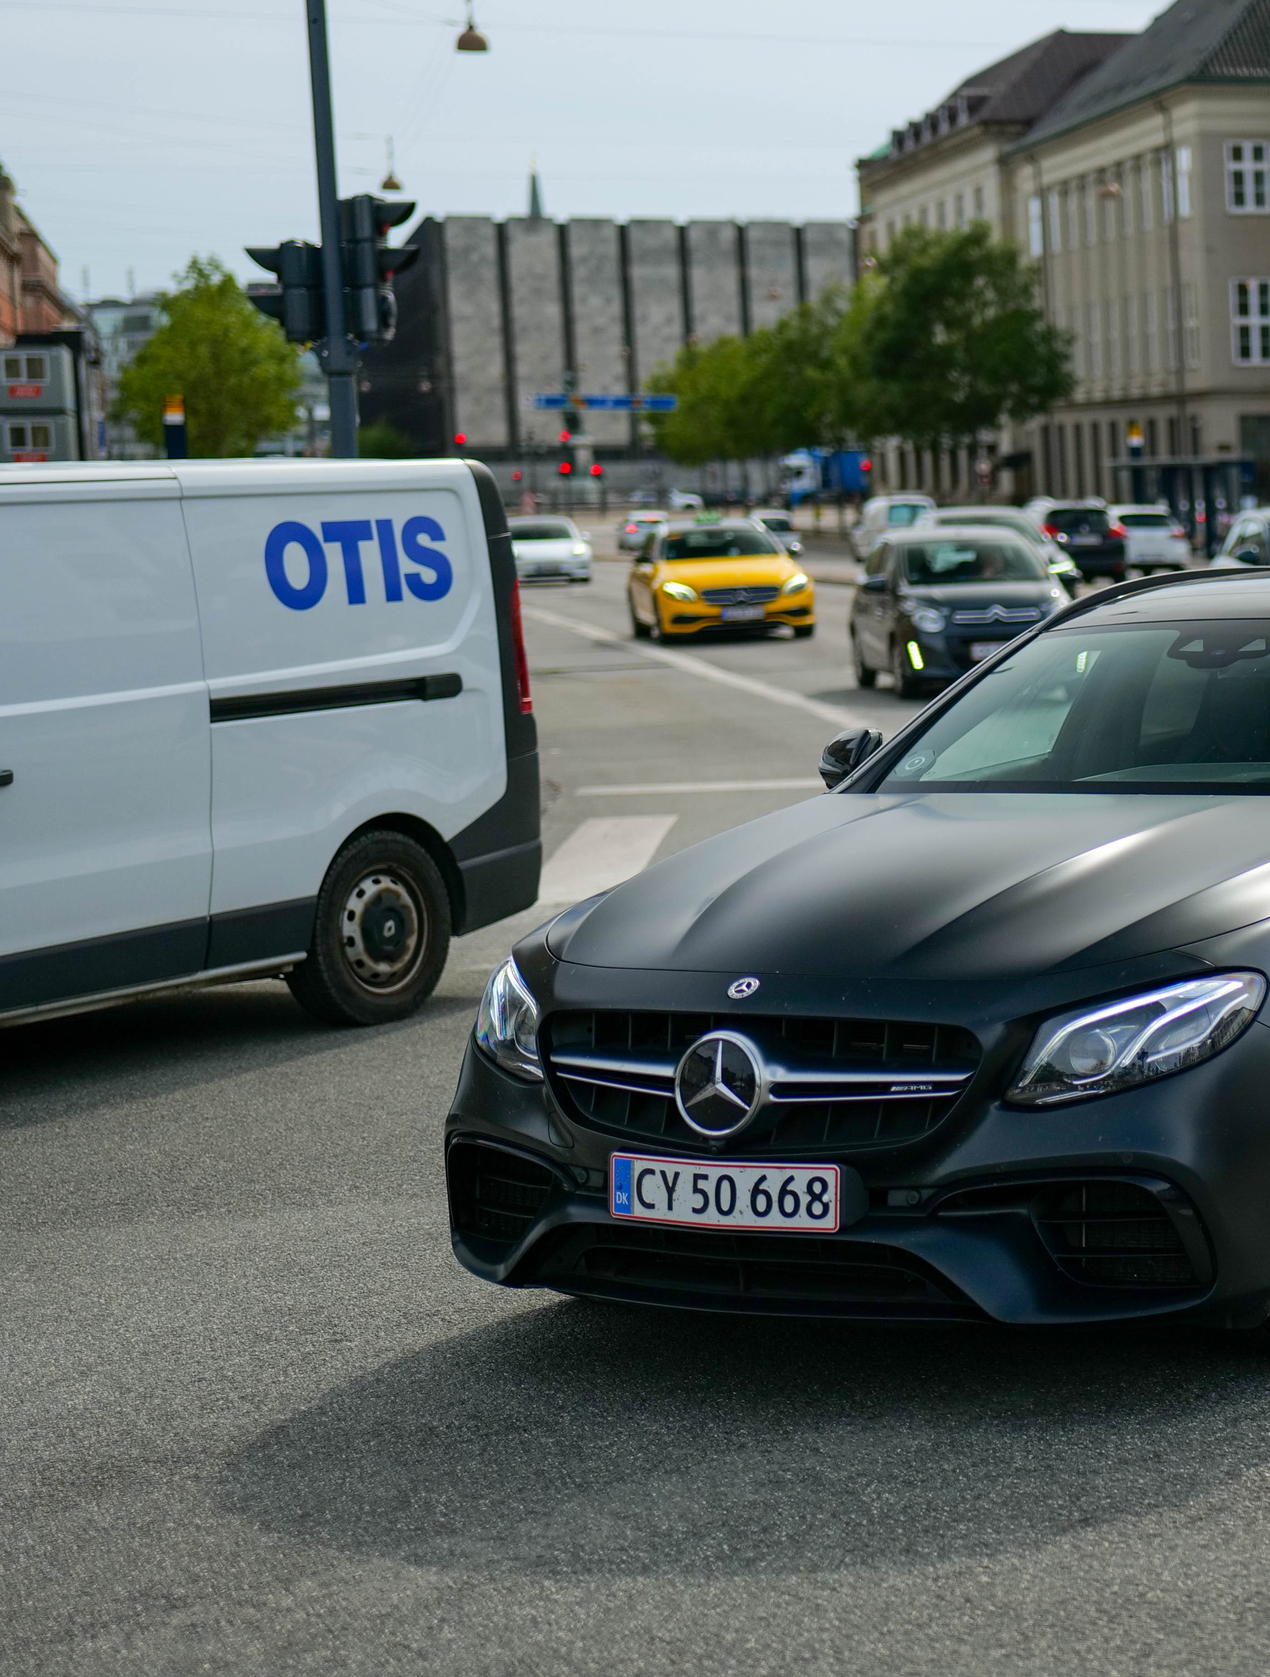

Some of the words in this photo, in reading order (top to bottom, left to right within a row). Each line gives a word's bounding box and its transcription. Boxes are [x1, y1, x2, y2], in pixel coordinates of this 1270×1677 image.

[264, 515, 453, 611] OTIS
[616, 1191, 629, 1205] DK
[636, 1168, 681, 1212] CY
[691, 1173, 737, 1216] 50
[750, 1174, 830, 1220] 668
